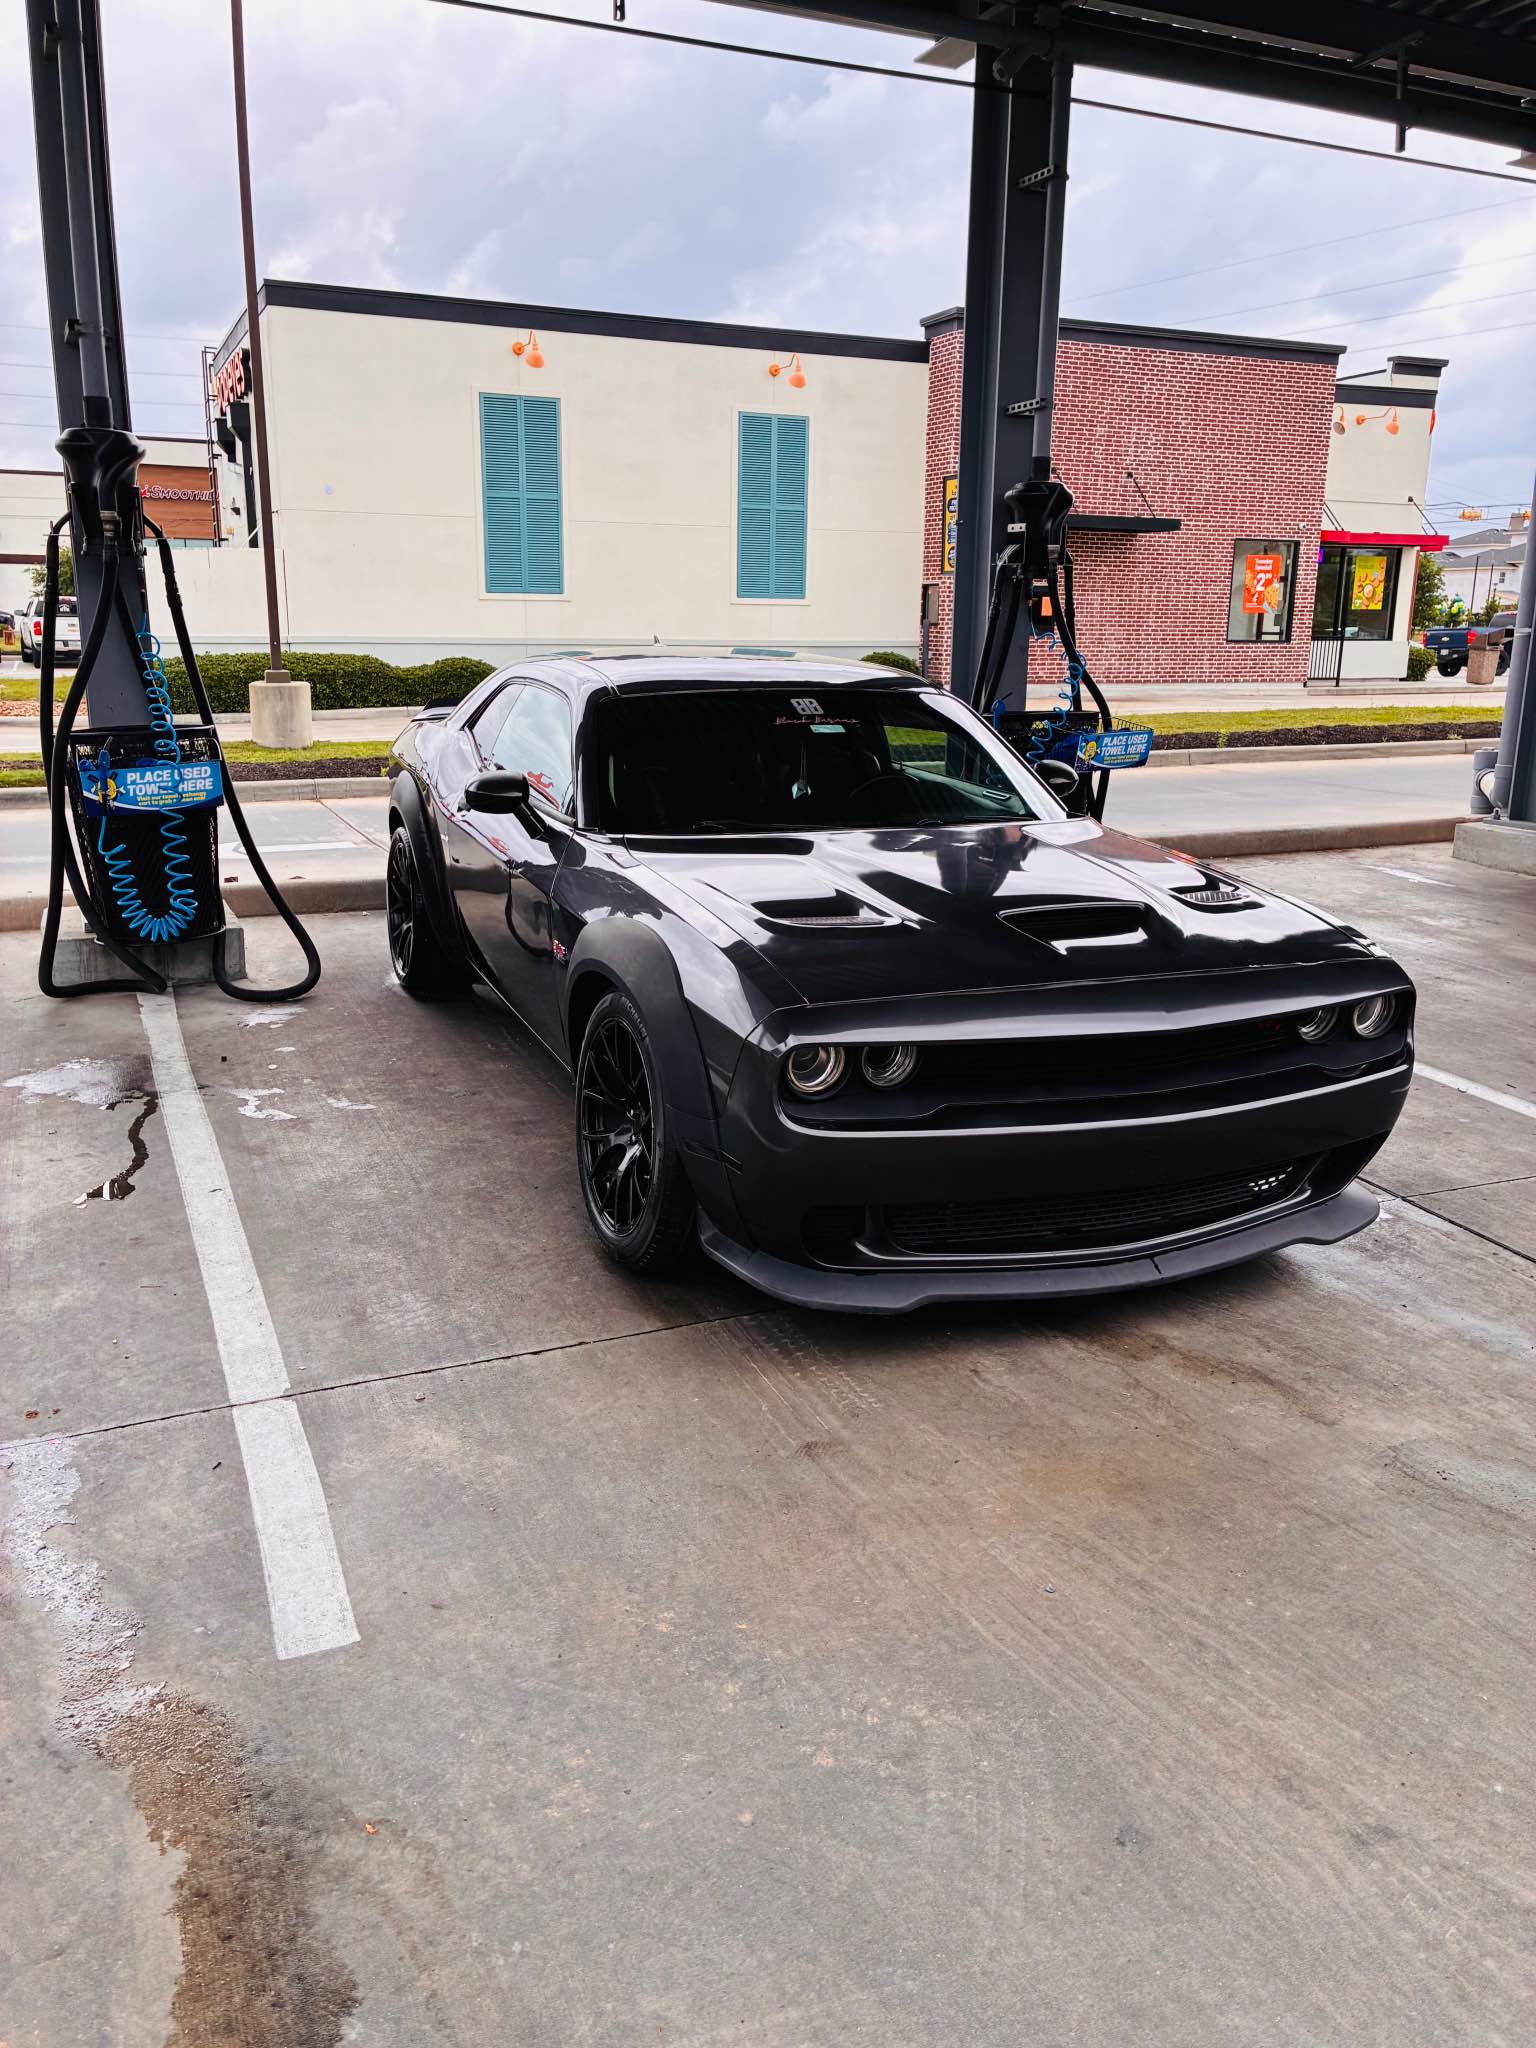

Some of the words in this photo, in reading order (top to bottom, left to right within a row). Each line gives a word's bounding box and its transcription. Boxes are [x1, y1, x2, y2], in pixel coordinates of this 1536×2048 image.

[1103, 736, 1127, 746] PLACE
[1128, 735, 1147, 744] USED
[1101, 745, 1126, 756] TOWEL
[1127, 744, 1147, 754] HERE
[127, 770, 171, 784] PLACE
[174, 767, 211, 780] USED
[179, 779, 213, 792] HERE
